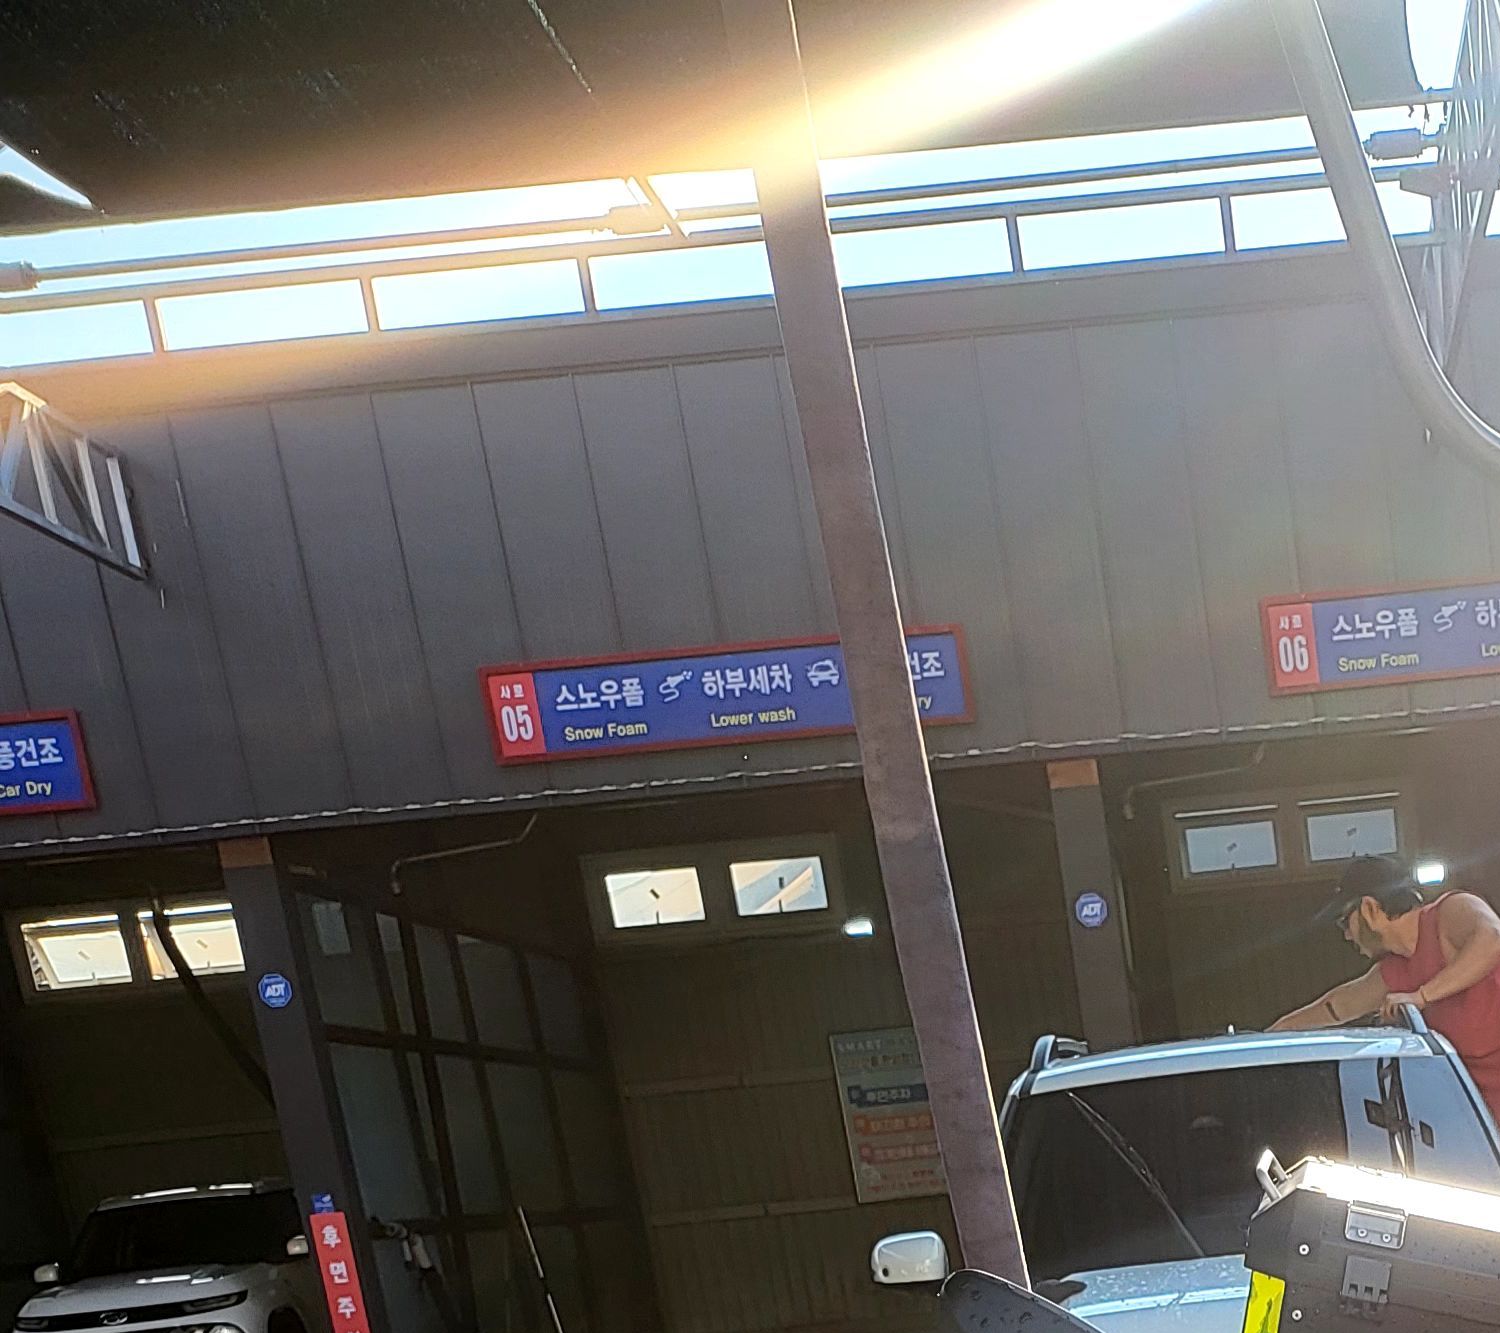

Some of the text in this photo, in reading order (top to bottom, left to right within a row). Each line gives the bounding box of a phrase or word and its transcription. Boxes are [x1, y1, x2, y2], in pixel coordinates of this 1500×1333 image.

[1332, 608, 1418, 641] 스노우폼
[1278, 635, 1309, 673] 06
[1338, 656, 1377, 672] Snow
[1380, 652, 1420, 669] Foam
[555, 677, 645, 711] 스노우폼
[701, 662, 792, 699] 하부세차
[501, 704, 534, 742] 05
[564, 695, 932, 742] Snow Foam Lower wash ry
[25, 780, 52, 796] Dry
[265, 983, 285, 998] ADT
